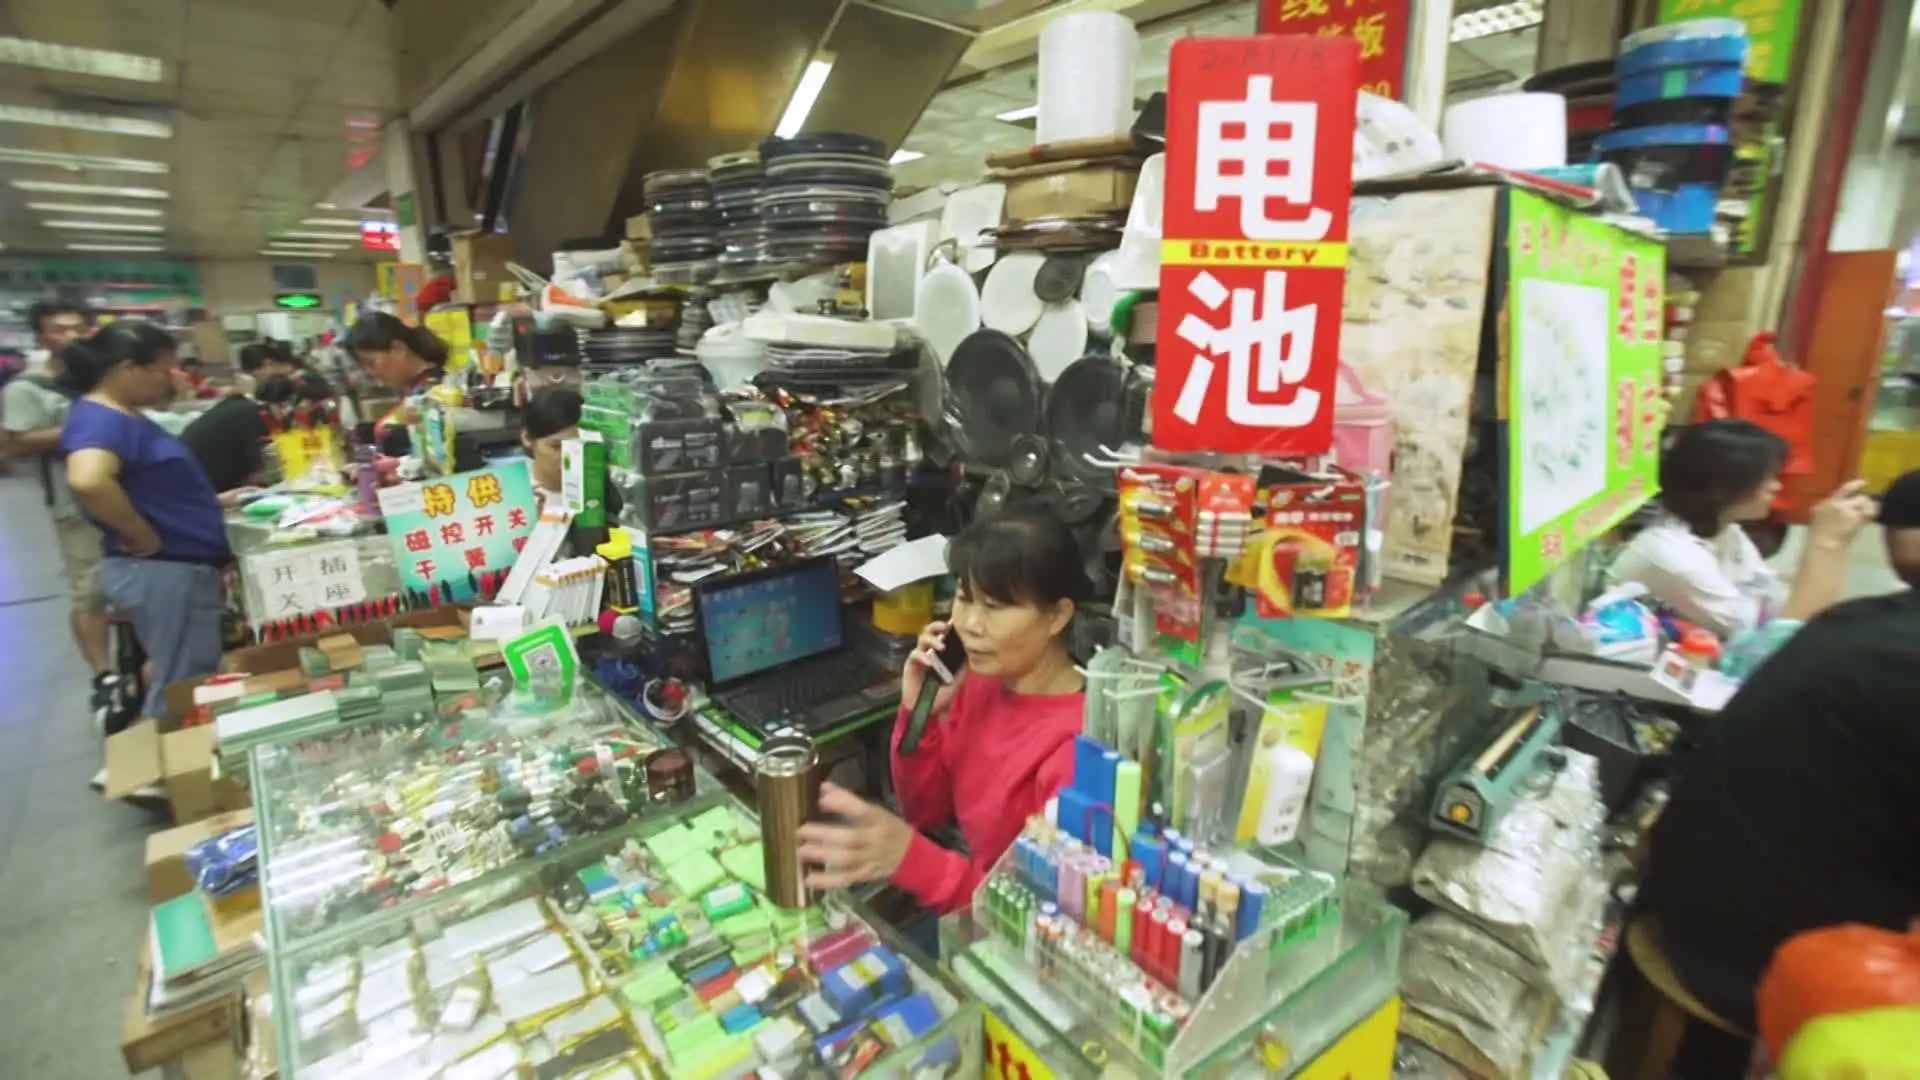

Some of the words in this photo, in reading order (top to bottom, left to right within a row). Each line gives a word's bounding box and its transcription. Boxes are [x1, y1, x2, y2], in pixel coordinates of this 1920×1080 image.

[1194, 74, 1333, 241] 电
[1189, 243, 1318, 263] Battery
[1173, 270, 1321, 428] 池
[422, 473, 503, 518] 特供
